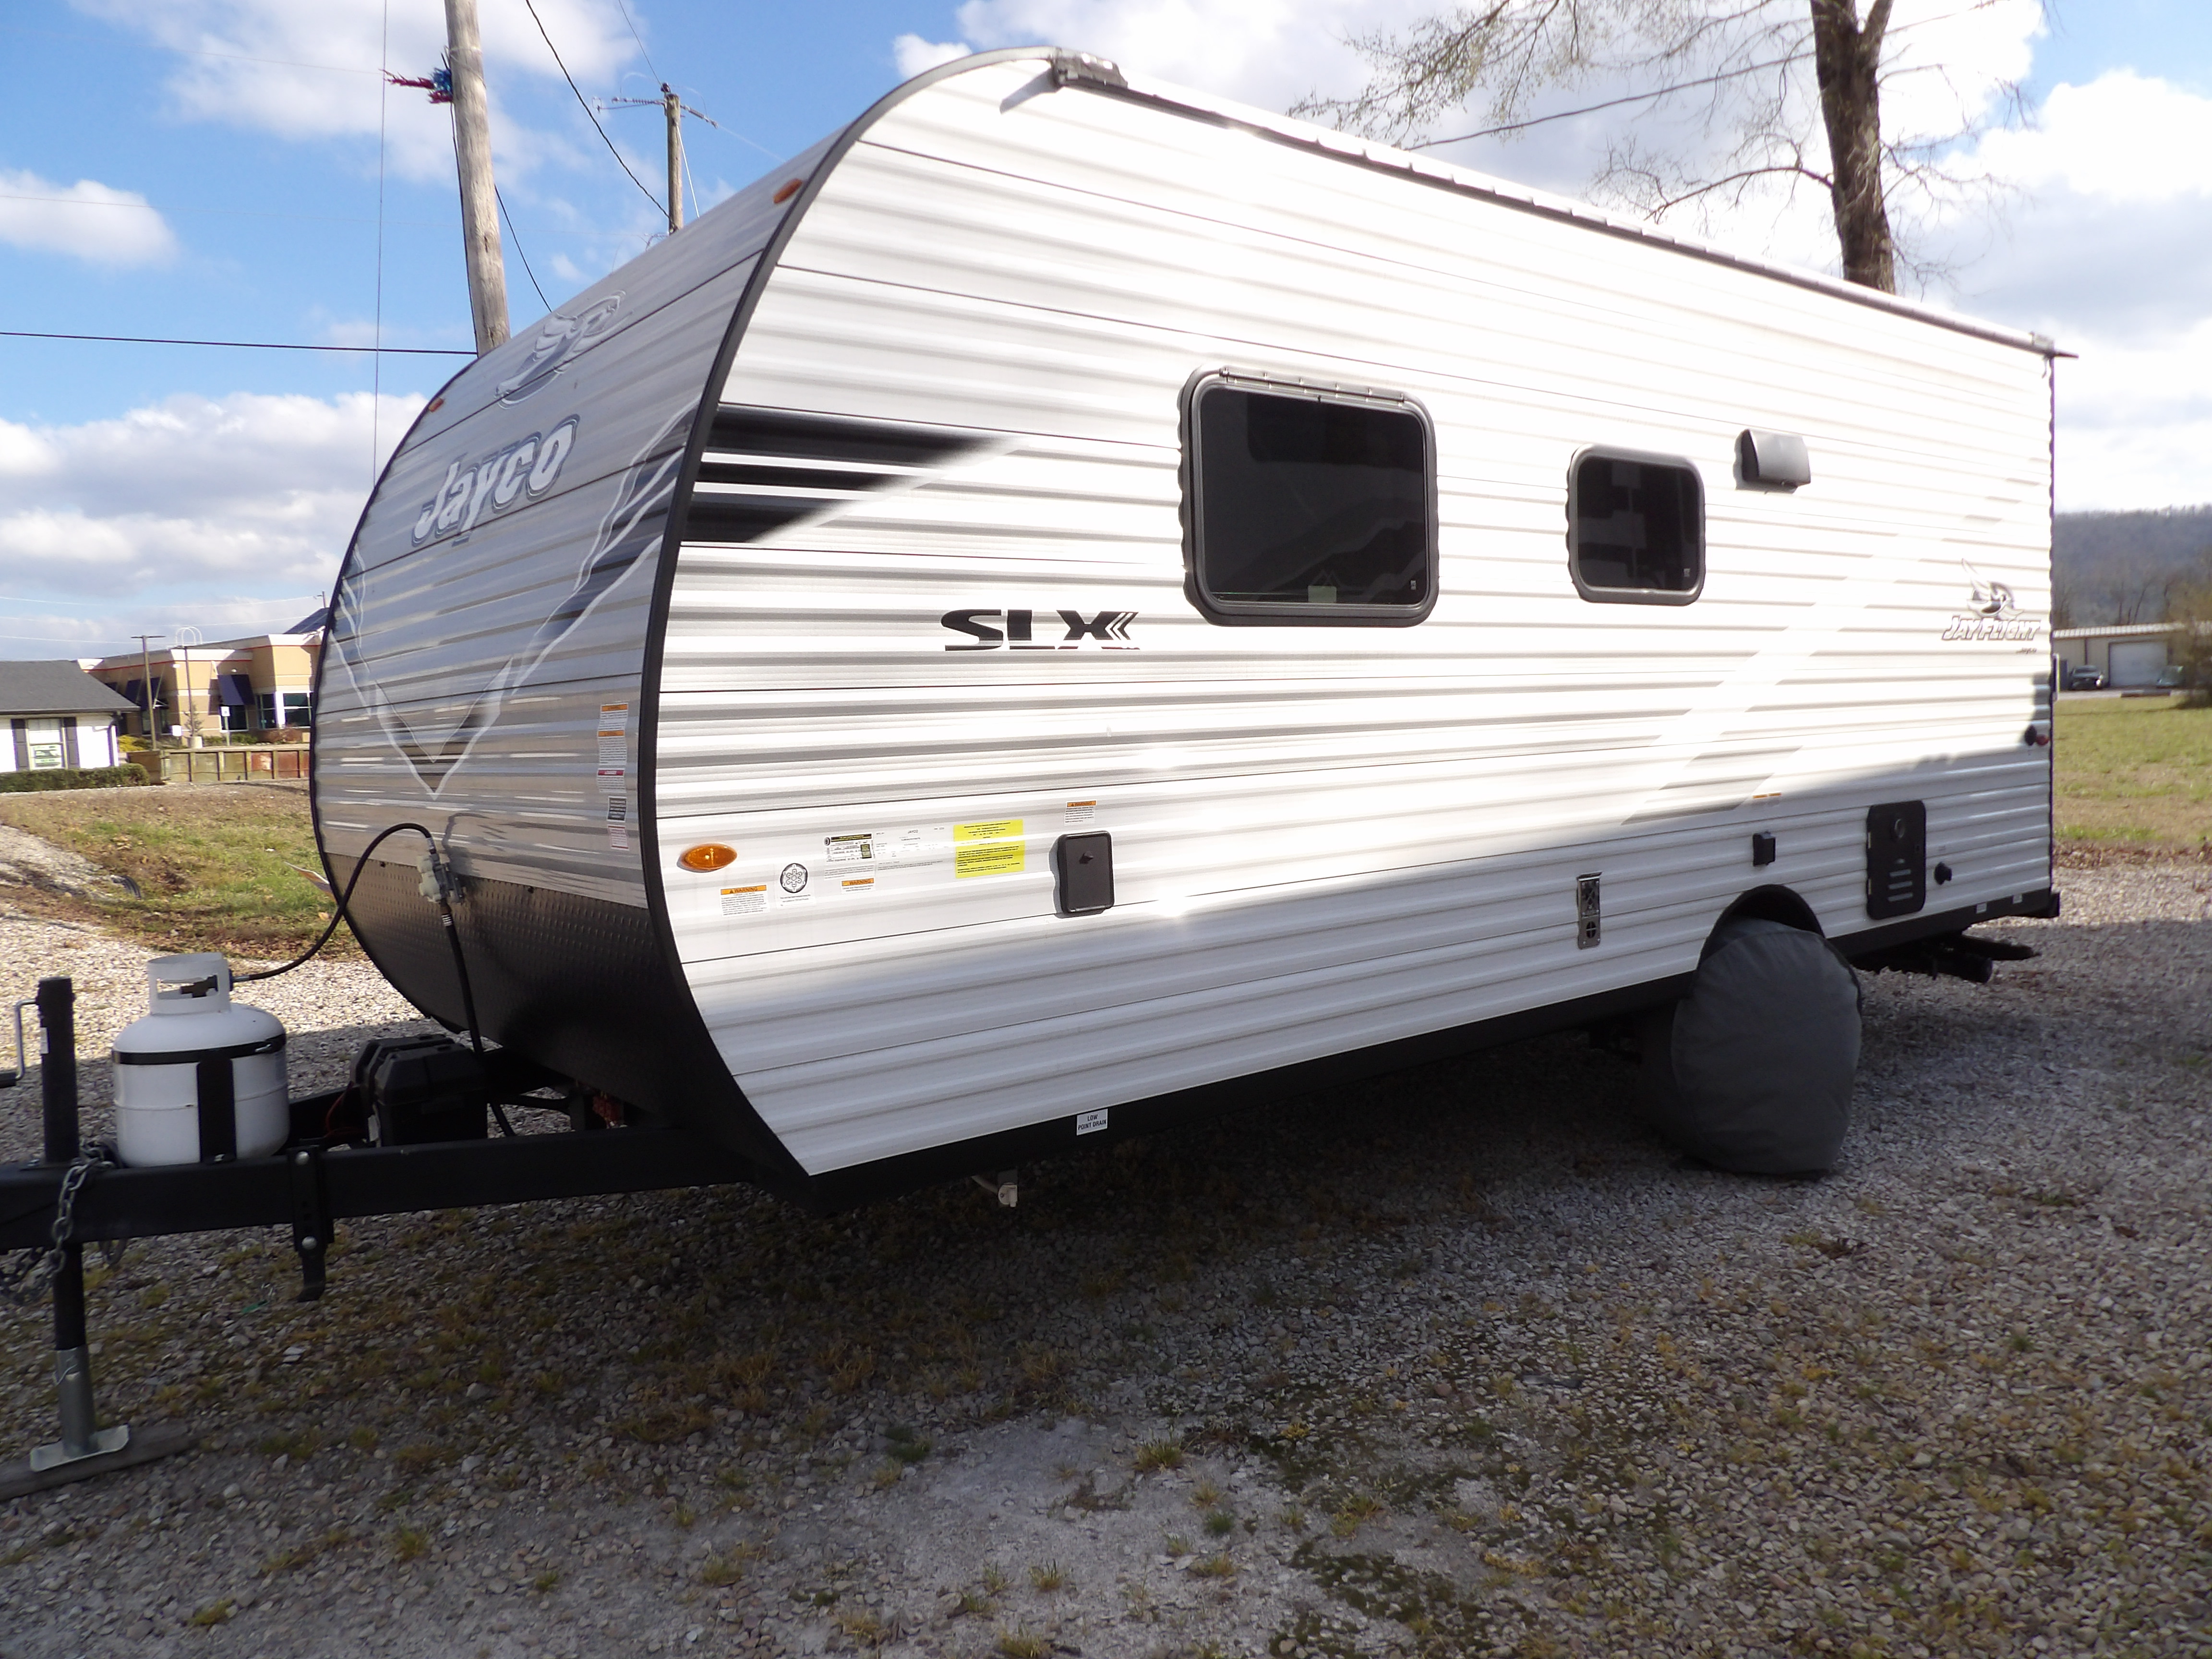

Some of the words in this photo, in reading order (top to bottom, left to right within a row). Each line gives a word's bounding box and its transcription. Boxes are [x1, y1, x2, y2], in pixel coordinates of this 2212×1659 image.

[411, 414, 580, 547] Jayco
[941, 609, 1140, 651] SLX
[1093, 1119, 1106, 1127] DRAIN
